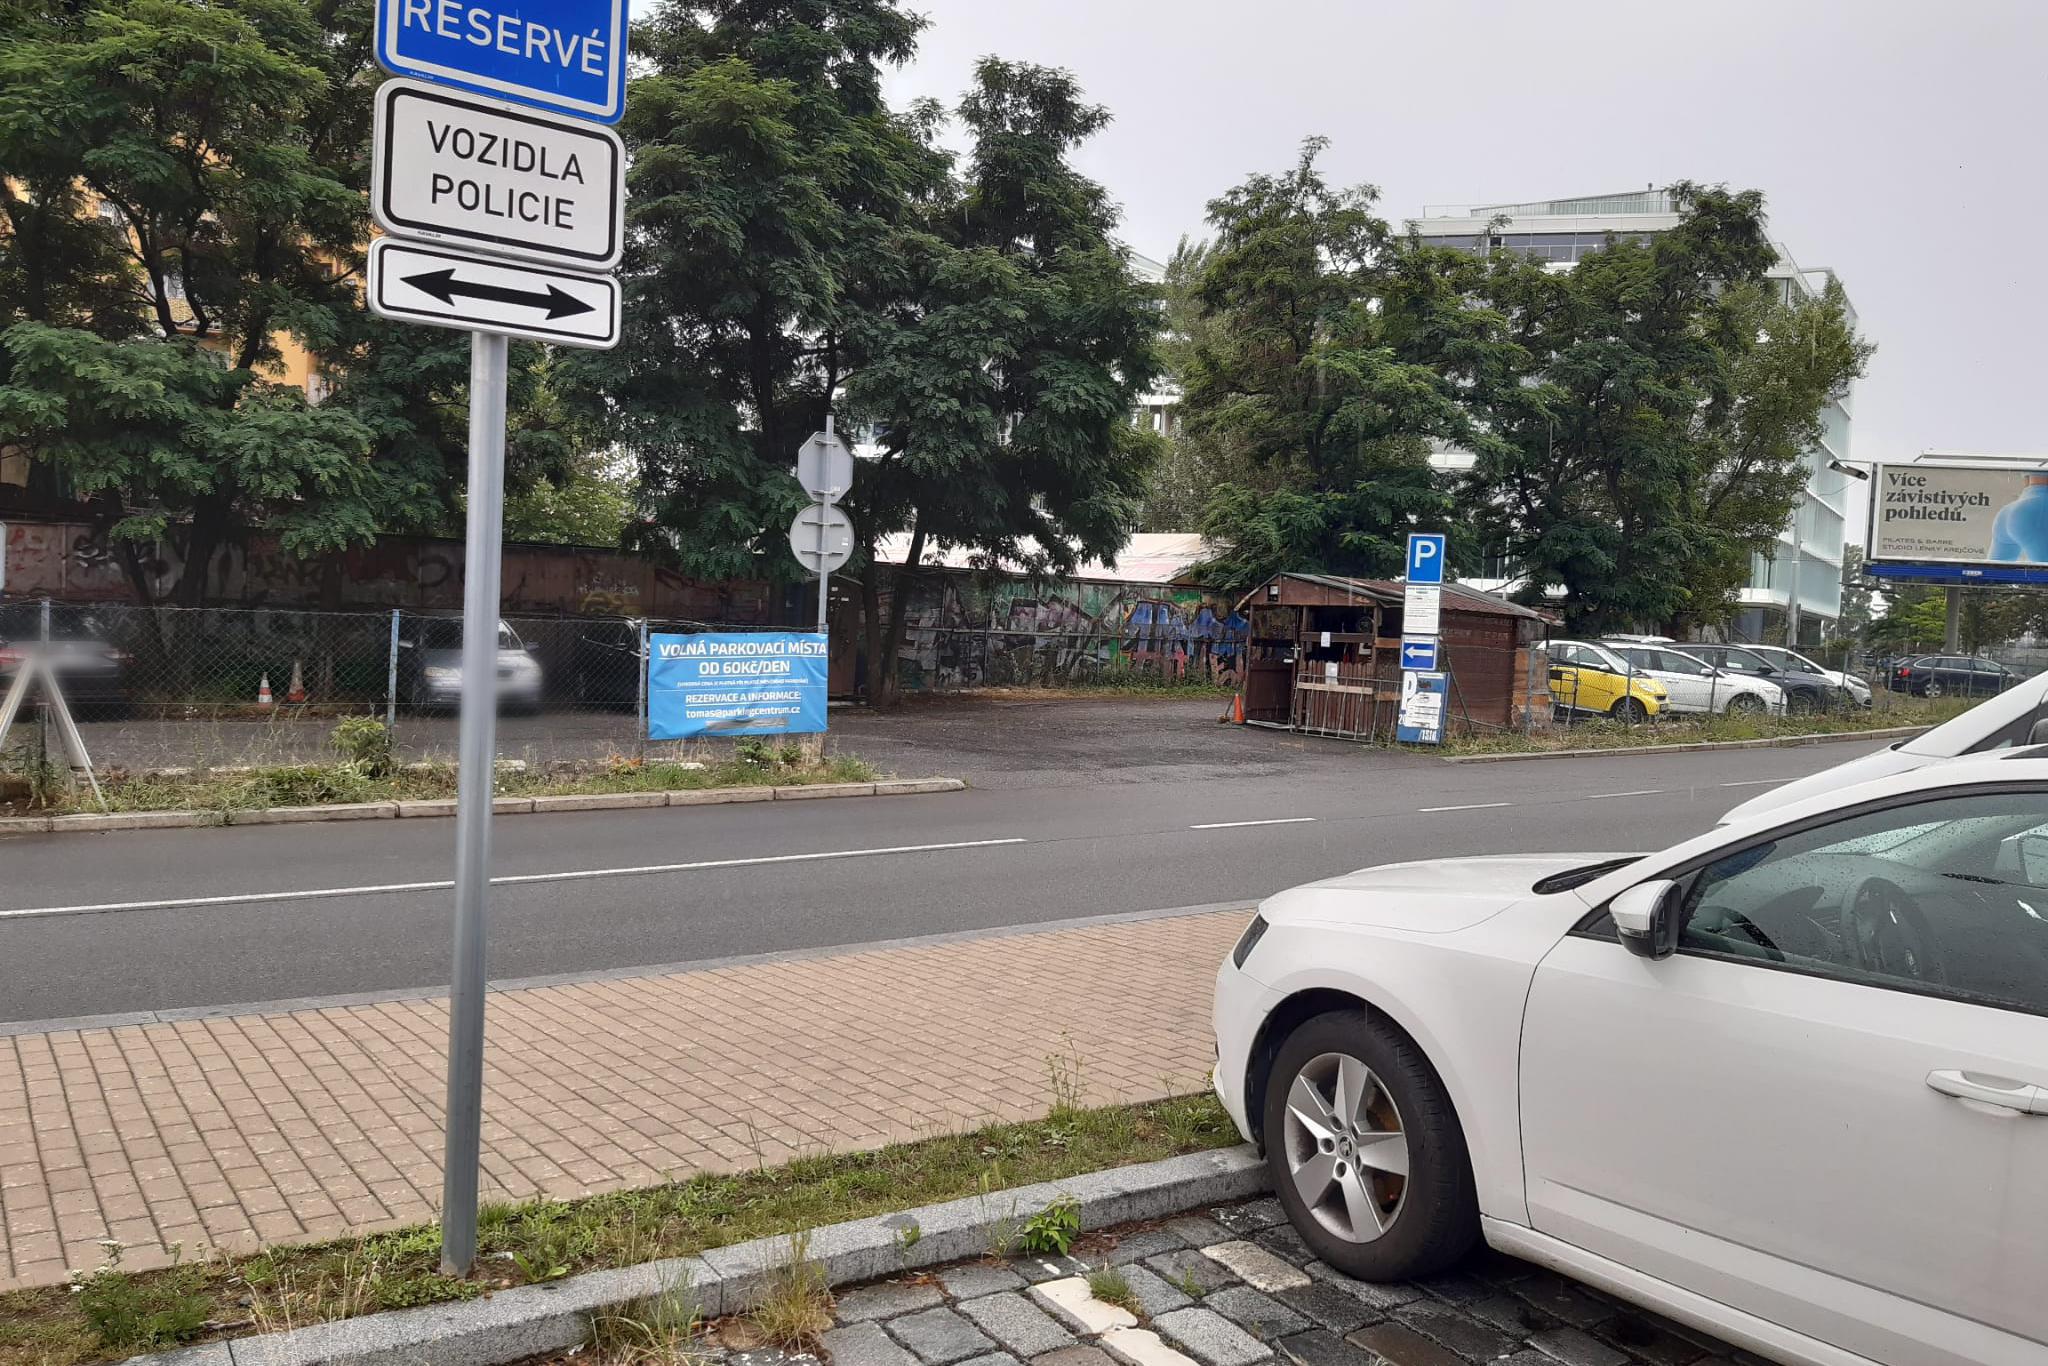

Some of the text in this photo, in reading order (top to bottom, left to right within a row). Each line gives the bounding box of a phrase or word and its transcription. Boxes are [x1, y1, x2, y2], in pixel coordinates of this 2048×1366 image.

[426, 120, 585, 185] VOZIDLA
[431, 173, 575, 230] POLICIE
[1888, 472, 1927, 487] Více
[1886, 488, 1991, 508] závistivých
[1884, 505, 1967, 522] pohledů.
[1414, 540, 1437, 568] P
[659, 639, 827, 657] VOLNÁ PARKOVACÍ MÍSTA
[699, 660, 790, 676] OD 60Kč/DEN
[685, 693, 739, 703] REZERVACE
[739, 693, 747, 702] A
